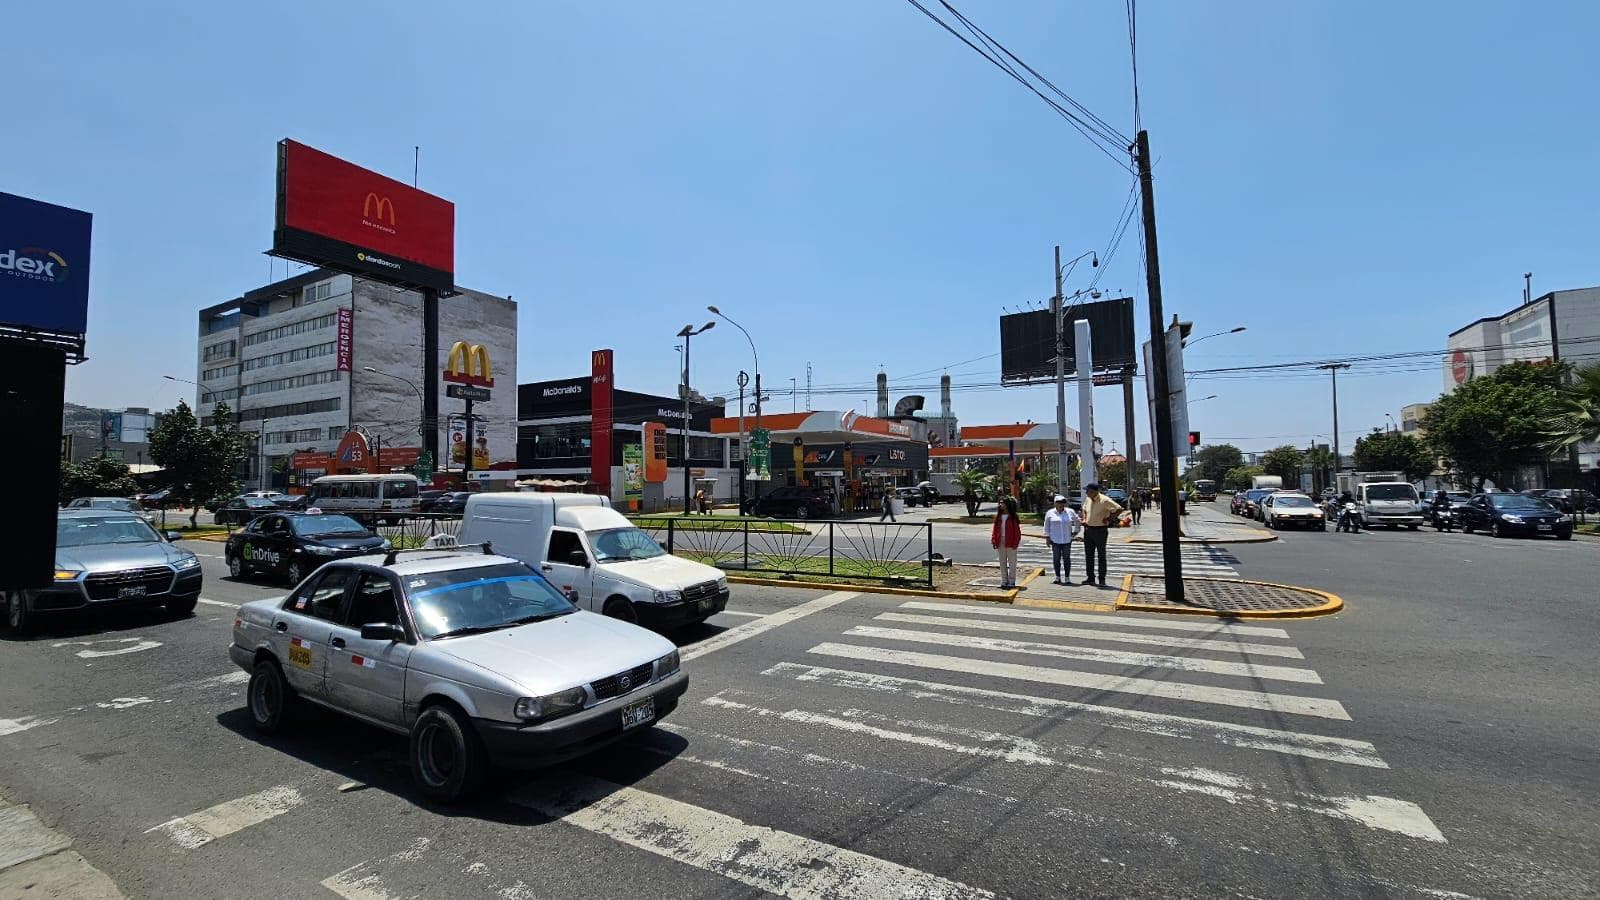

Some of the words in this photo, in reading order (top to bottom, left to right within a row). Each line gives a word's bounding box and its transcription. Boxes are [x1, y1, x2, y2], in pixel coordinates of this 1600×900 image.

[7, 270, 55, 282] OUTDOOR
[340, 310, 350, 369] EMERGENCIA
[543, 386, 582, 397] McDonald's
[433, 537, 455, 547] TAXI
[251, 546, 280, 563] inDrive
